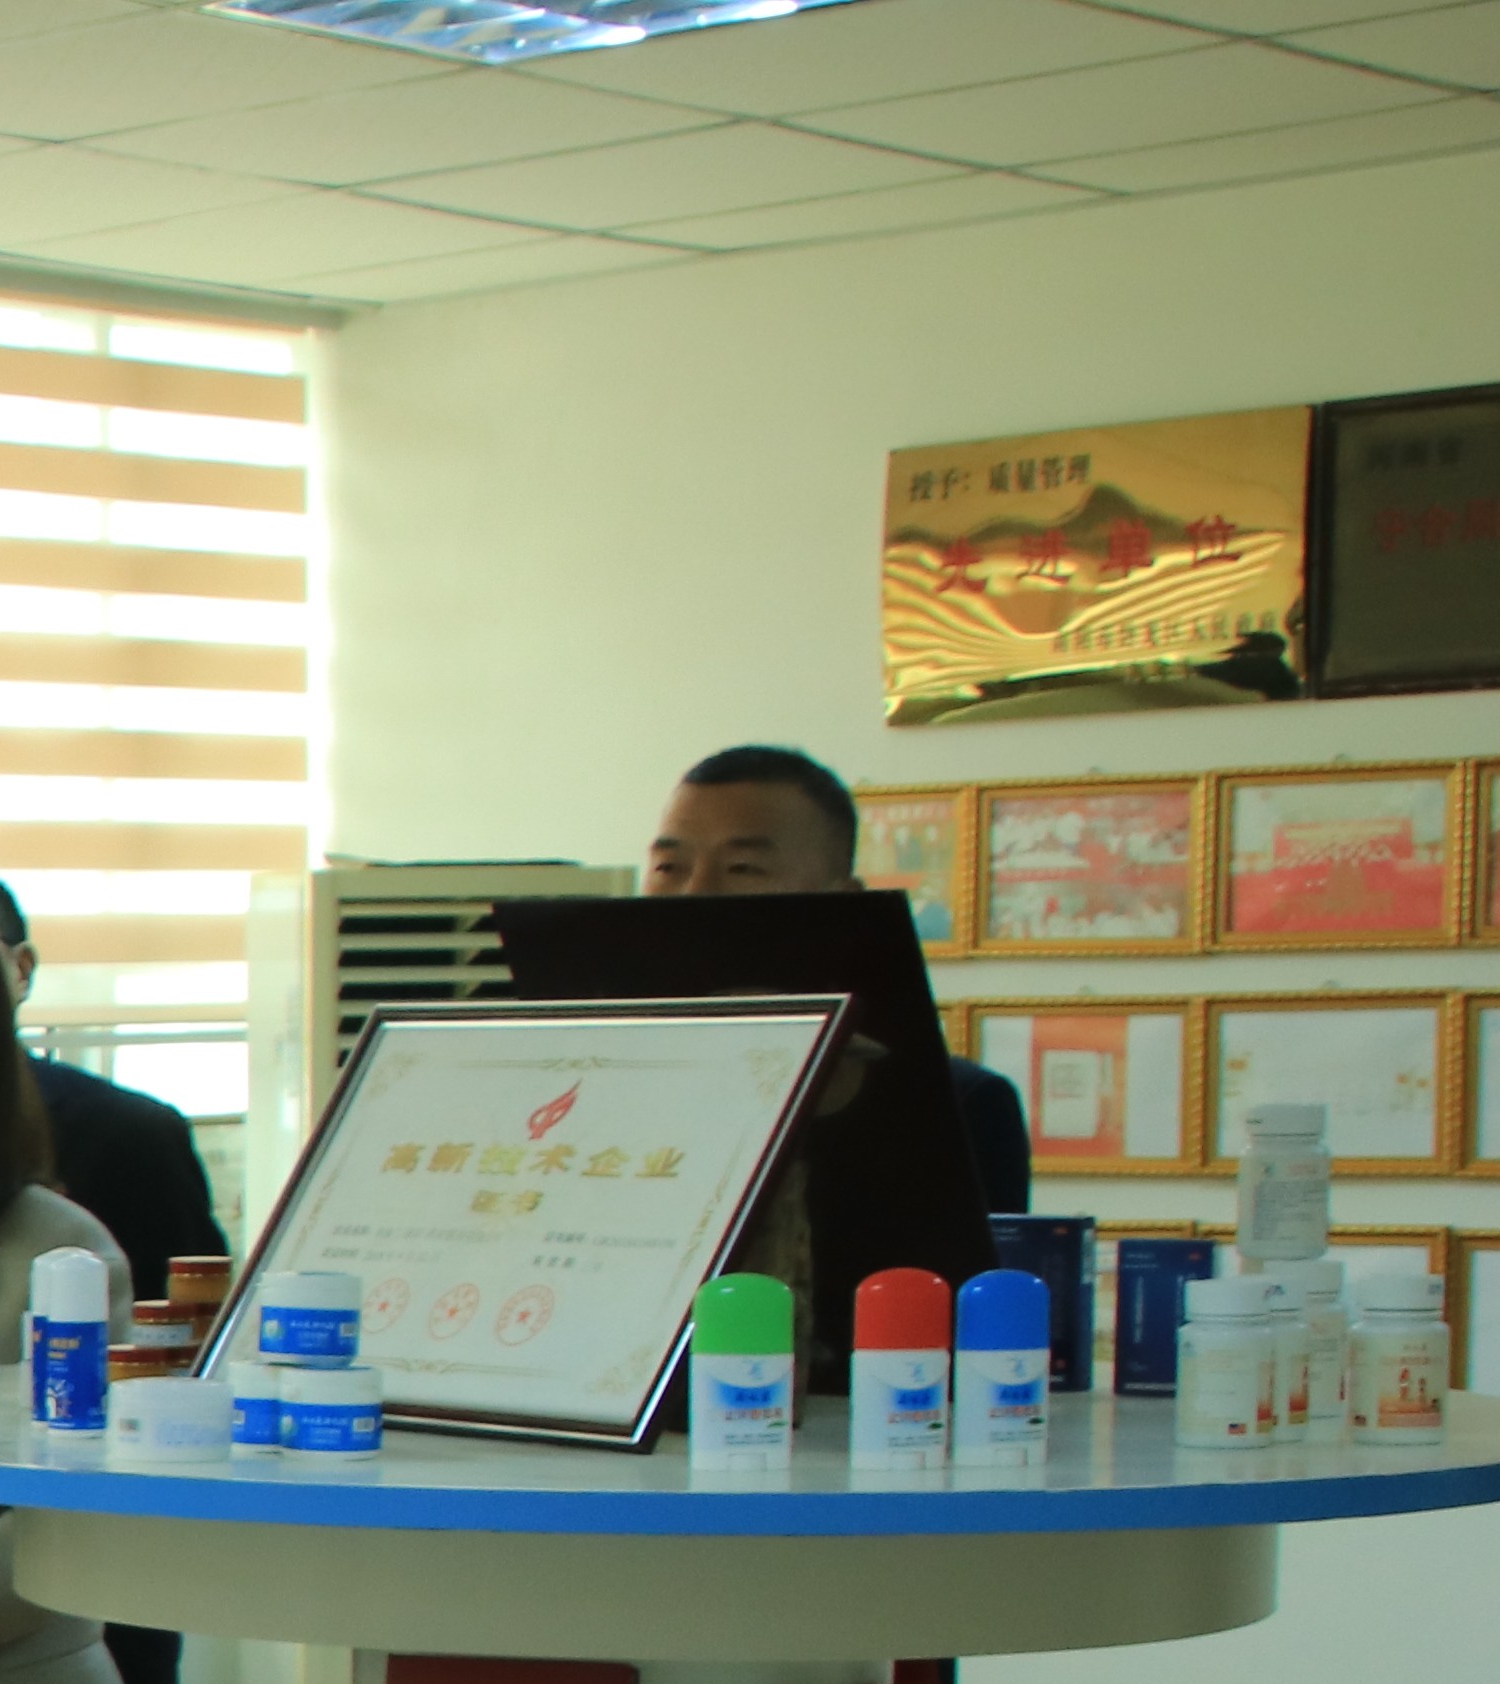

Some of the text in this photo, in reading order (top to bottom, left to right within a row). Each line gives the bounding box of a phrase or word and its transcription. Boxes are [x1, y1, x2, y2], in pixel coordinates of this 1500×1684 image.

[936, 513, 1243, 595] 先进单位
[380, 1142, 685, 1179] 高新技术企业
